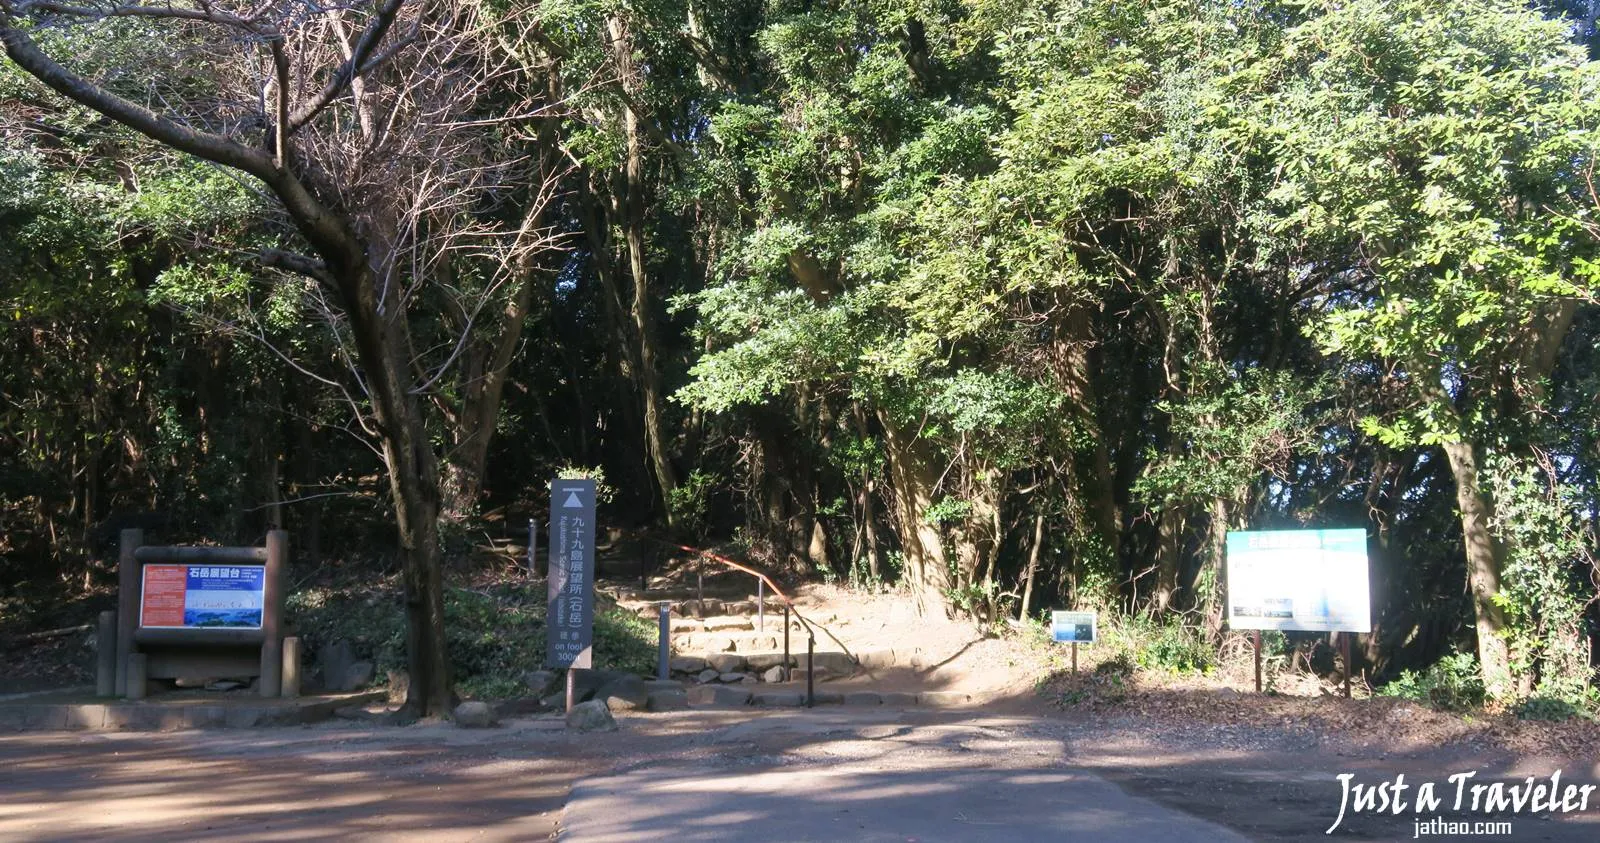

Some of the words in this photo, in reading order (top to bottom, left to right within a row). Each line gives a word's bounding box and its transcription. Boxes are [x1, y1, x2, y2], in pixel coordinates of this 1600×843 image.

[190, 567, 240, 578] 石岳展望台
